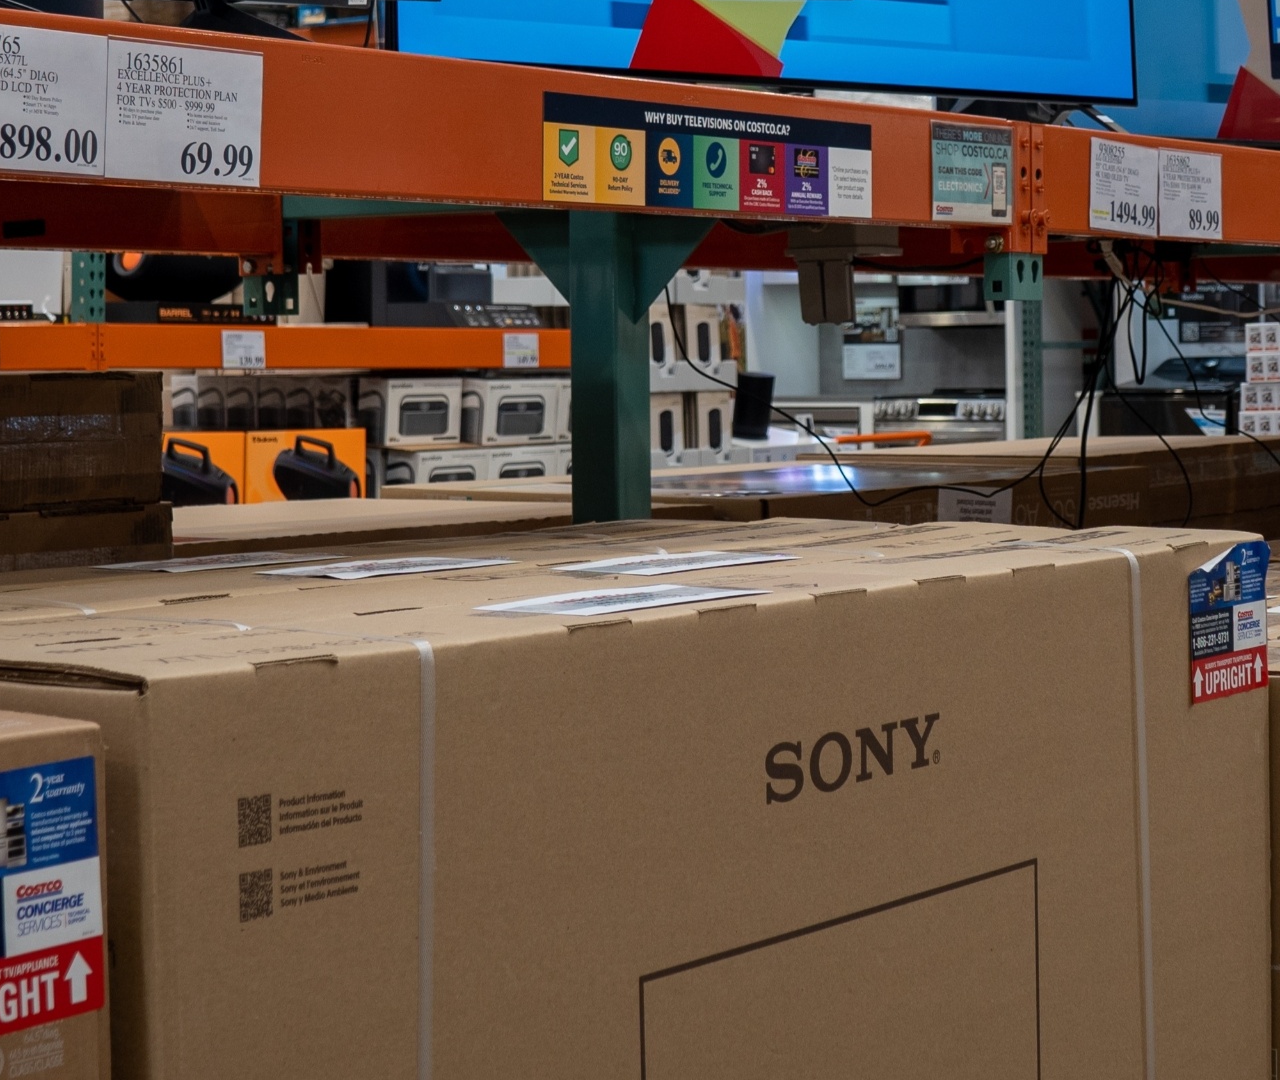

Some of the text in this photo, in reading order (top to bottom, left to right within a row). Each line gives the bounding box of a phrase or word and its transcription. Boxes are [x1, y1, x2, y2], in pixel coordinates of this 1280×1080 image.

[126, 52, 184, 75] 1635861
[30, 70, 58, 84] DIAG)
[117, 69, 212, 87] EXCELLENCE PLUS+
[11, 82, 32, 93] LCD
[35, 84, 49, 95] TV
[117, 82, 238, 102] 4 YEAR PROTECTION PLAN
[117, 95, 215, 113] FOR TVs $500 $999.99
[645, 111, 791, 136] WHY BUY TELEVISIONS ON COSTCO.CA?
[0, 123, 98, 164] 898.00
[614, 142, 628, 156] 90
[936, 143, 1008, 159] SHOP COSTCO.CA
[180, 141, 253, 178] 69.99
[938, 166, 953, 174] SCAN
[938, 181, 982, 192] ELECTRONICS
[1110, 200, 1155, 227] 1494.99
[1189, 209, 1219, 231] 89.99
[160, 308, 192, 318] BARREL
[1238, 620, 1260, 631] CONCIERGE
[1205, 663, 1252, 695] UPRIGHT
[763, 712, 941, 806] SONY
[46, 782, 86, 798] warranty
[279, 790, 346, 808] Product Information
[16, 879, 62, 898] COSTCO
[17, 893, 84, 920] CONCIERGE
[17, 915, 62, 937] SERVICES
[4, 955, 59, 979] TV/APPLIANCE
